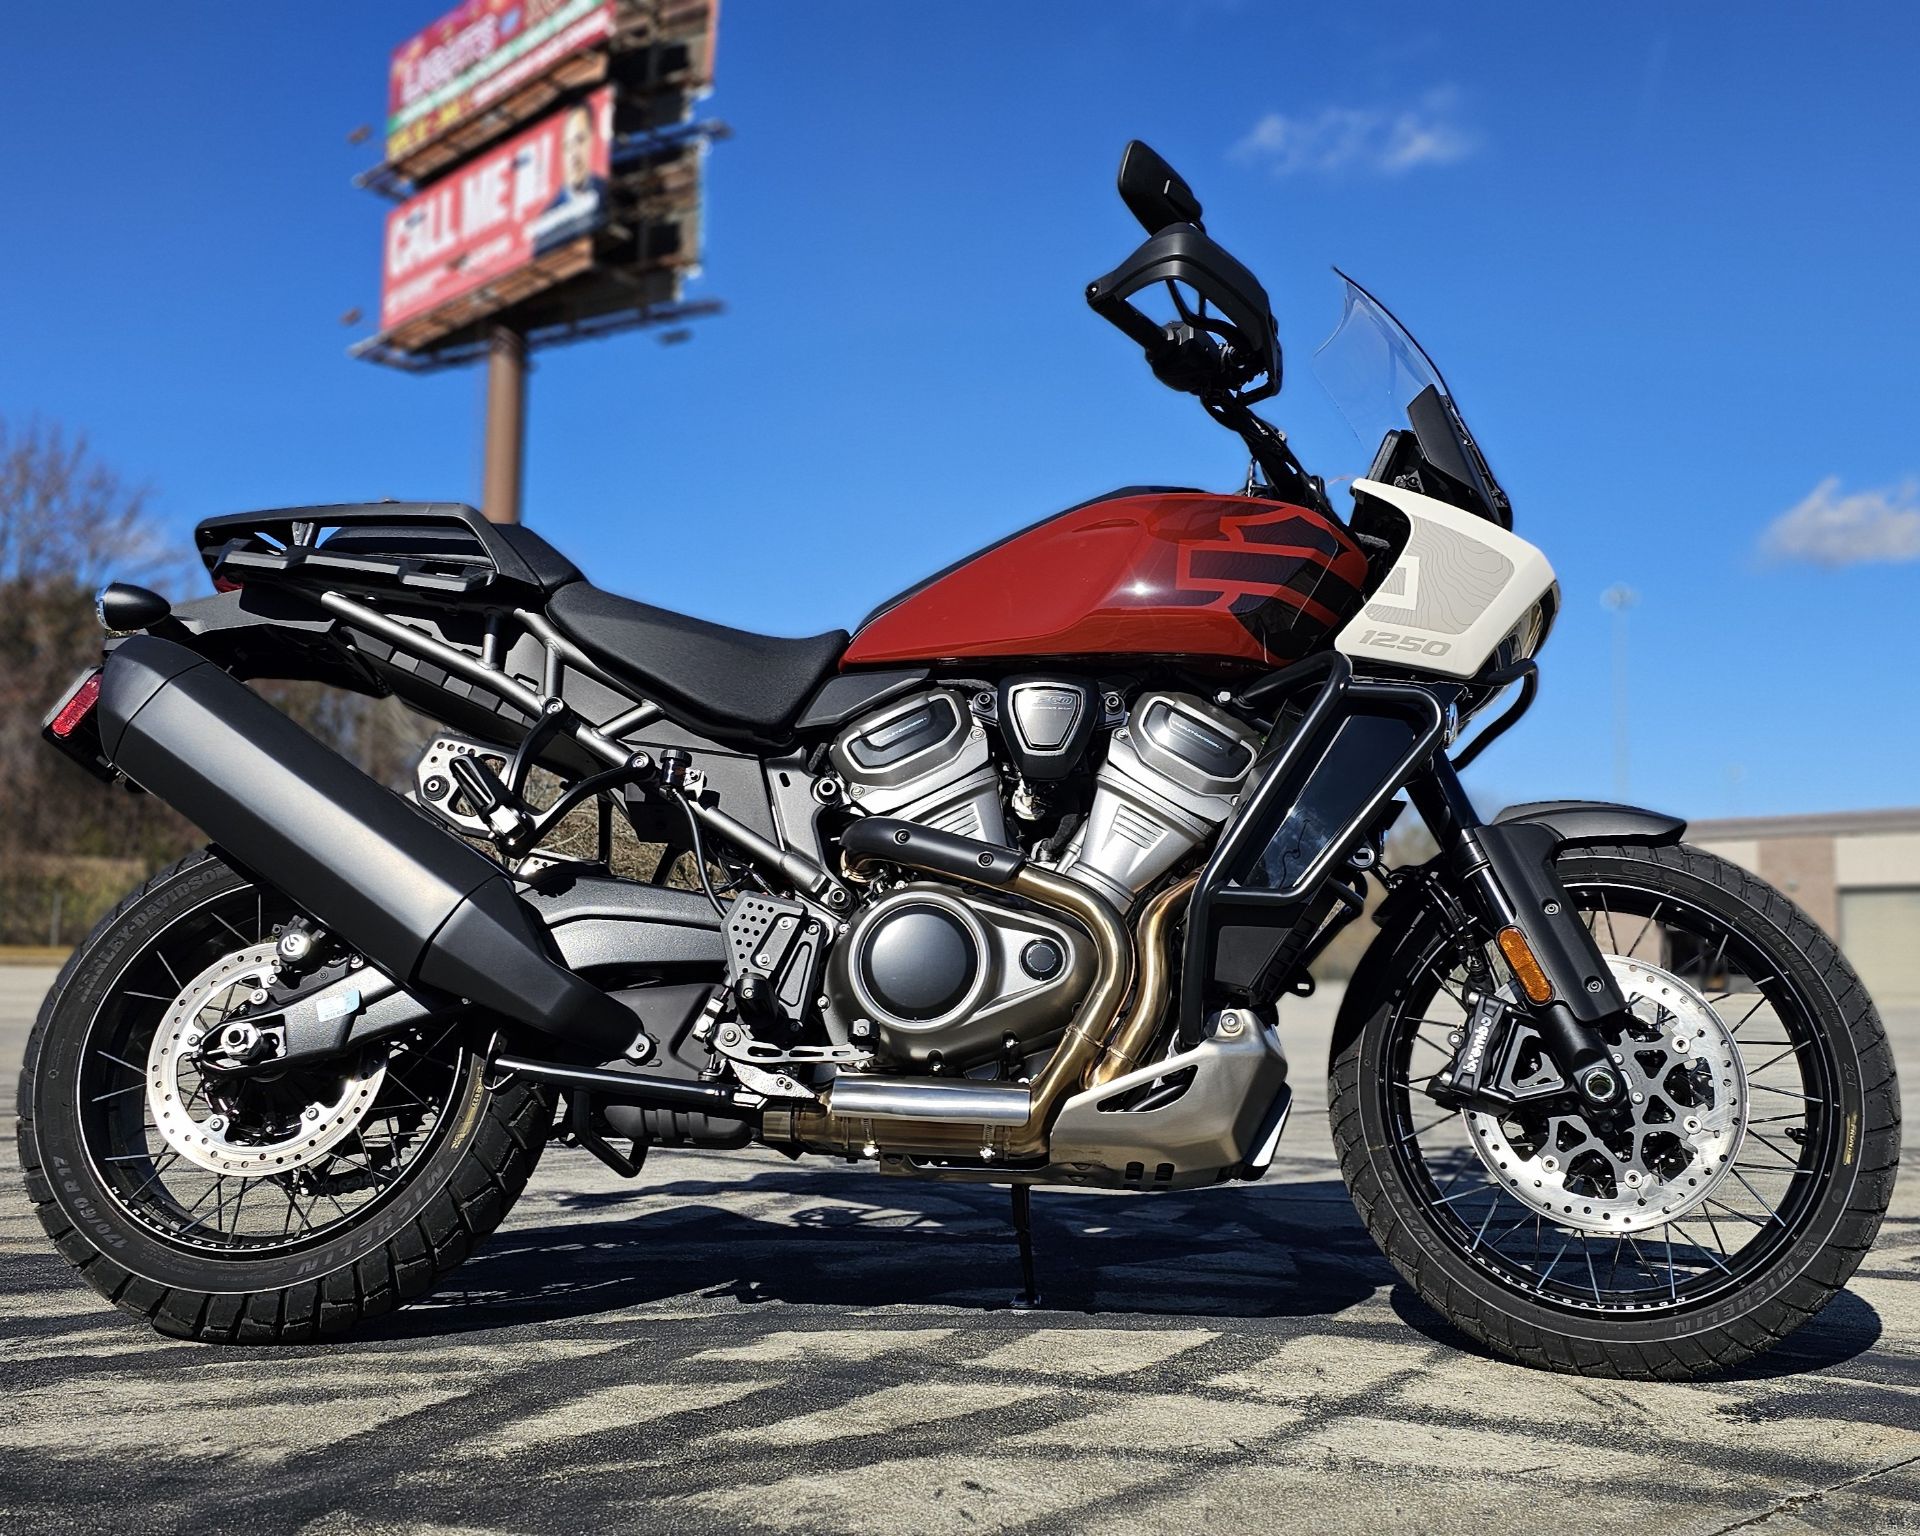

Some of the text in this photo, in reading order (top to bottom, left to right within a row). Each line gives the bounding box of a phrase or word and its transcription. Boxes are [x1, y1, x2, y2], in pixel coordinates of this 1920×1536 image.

[1358, 629, 1452, 657] 1250
[1462, 1016, 1492, 1073] brembo
[297, 1164, 444, 1276] MICHELIN
[1675, 1260, 1797, 1334] MICHELIN
